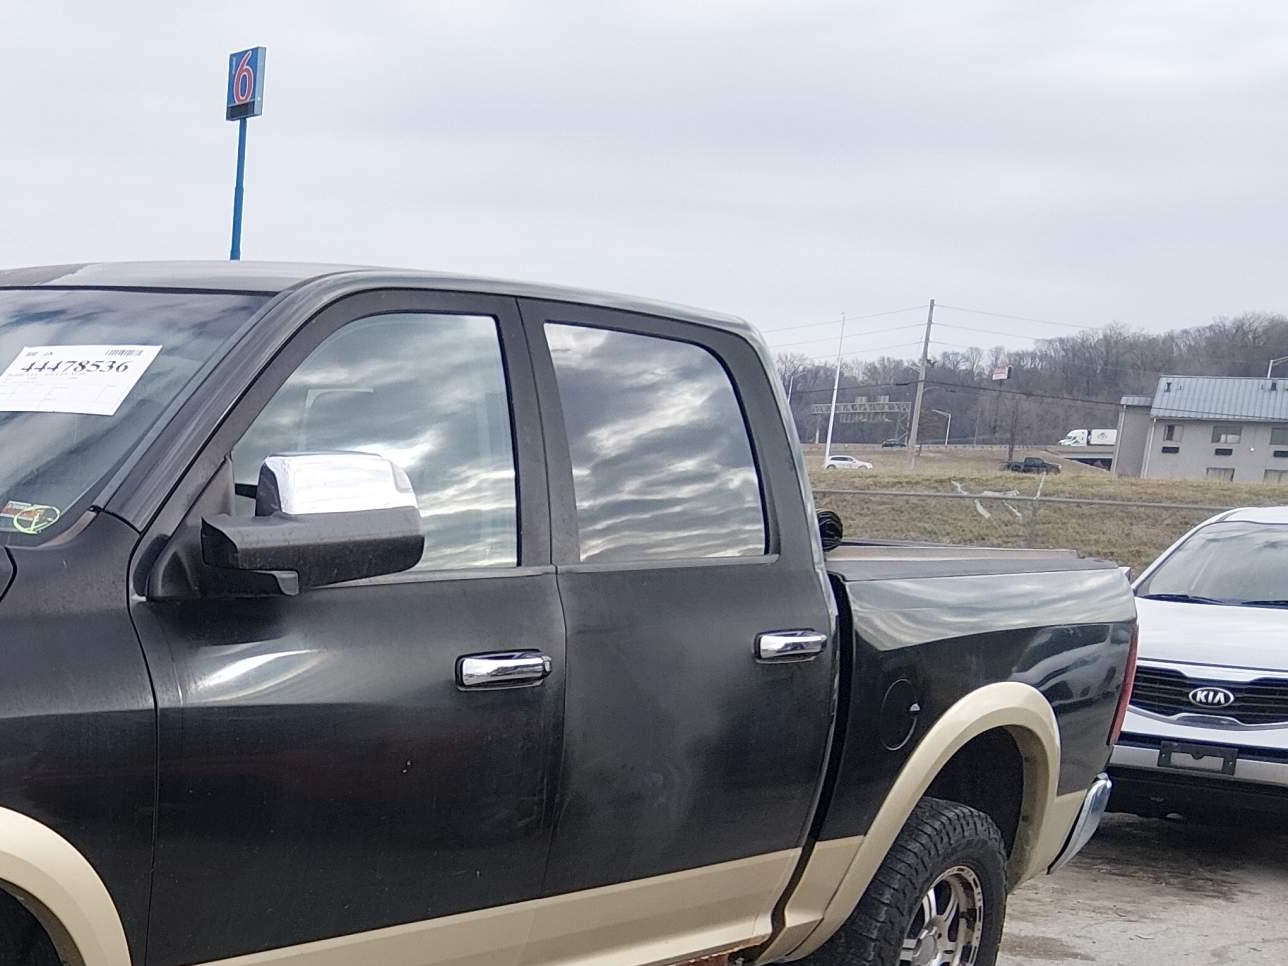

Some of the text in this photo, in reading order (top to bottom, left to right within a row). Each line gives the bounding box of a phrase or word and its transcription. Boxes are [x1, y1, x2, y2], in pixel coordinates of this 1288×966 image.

[234, 50, 253, 104] 6
[21, 360, 133, 373] 44478536
[1196, 691, 1225, 704] KIA
